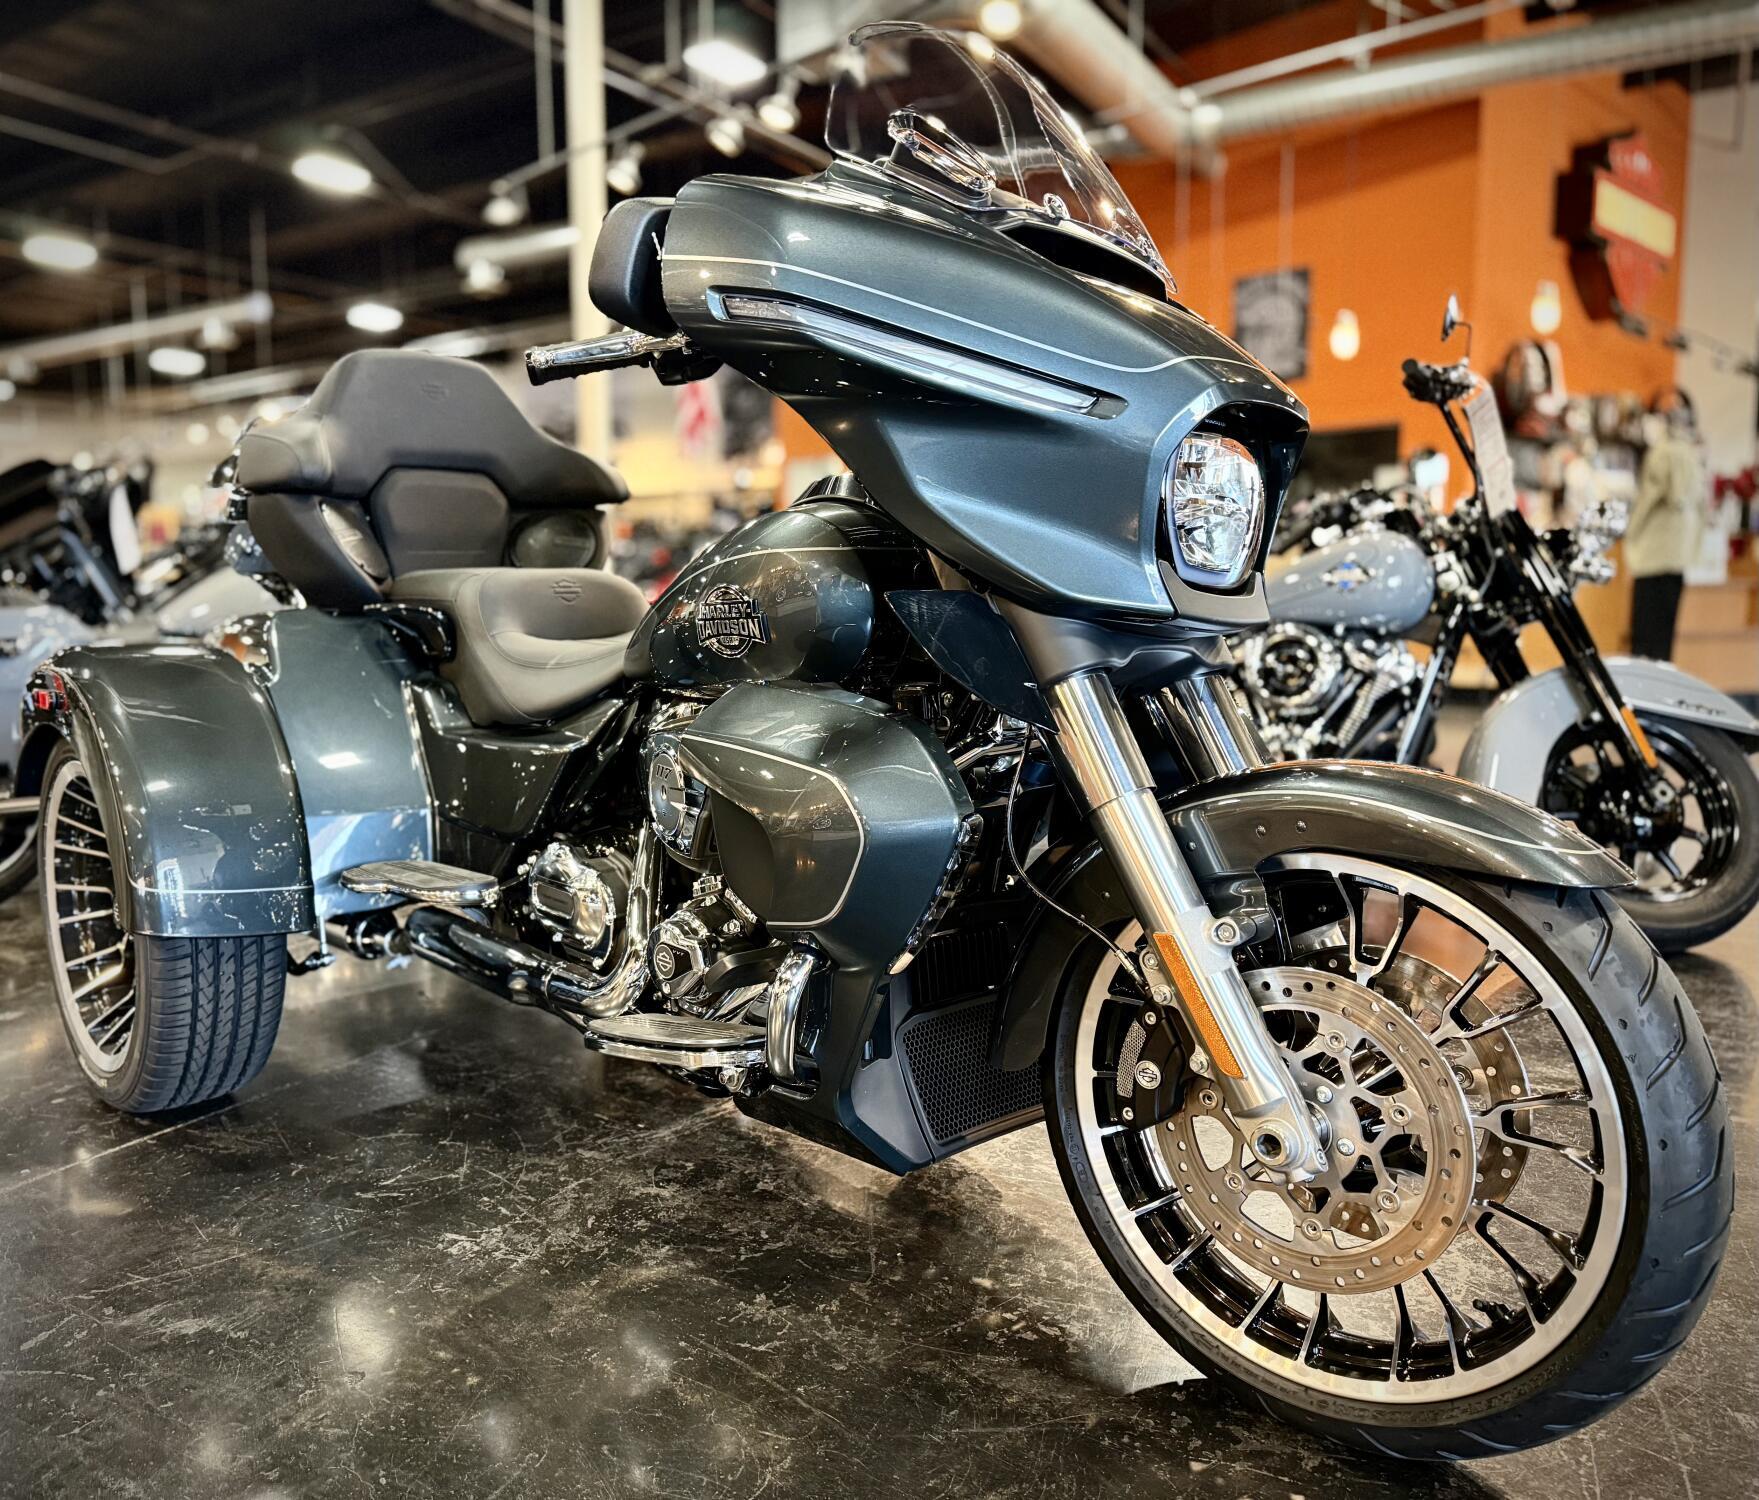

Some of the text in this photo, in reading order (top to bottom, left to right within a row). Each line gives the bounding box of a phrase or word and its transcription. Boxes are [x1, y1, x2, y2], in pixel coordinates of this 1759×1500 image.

[700, 603, 751, 619] HARLEY-
[697, 618, 762, 641] DAVIDSON
[656, 764, 673, 780] 117
